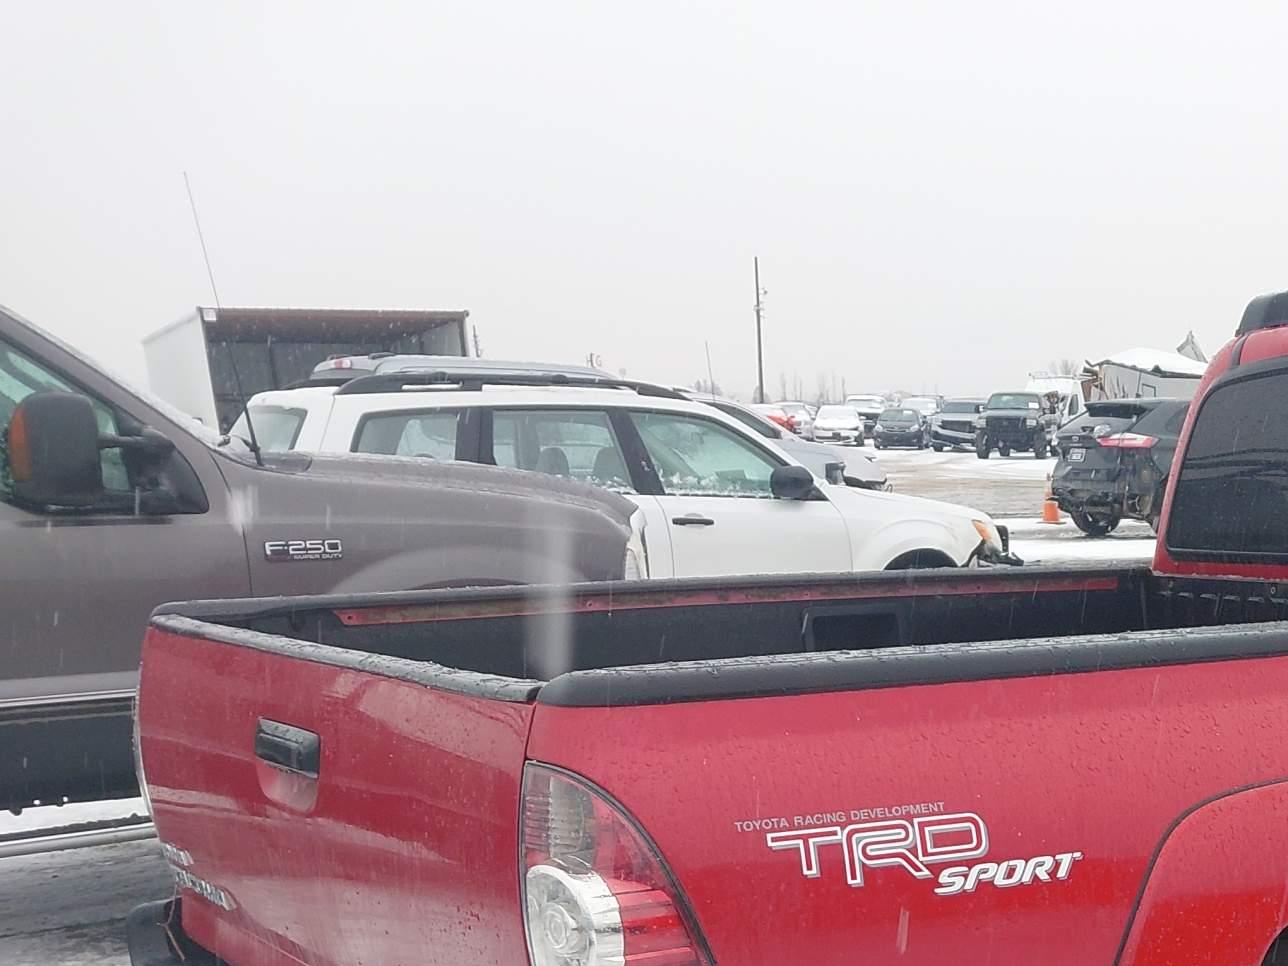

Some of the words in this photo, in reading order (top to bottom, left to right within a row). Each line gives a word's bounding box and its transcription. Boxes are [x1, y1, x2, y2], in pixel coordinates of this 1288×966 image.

[734, 818, 790, 833] TOYOTA
[793, 811, 847, 827] RACING
[850, 801, 946, 821] DEVELOPMENT
[766, 812, 990, 887] TRD
[933, 850, 1083, 895] SPORT
